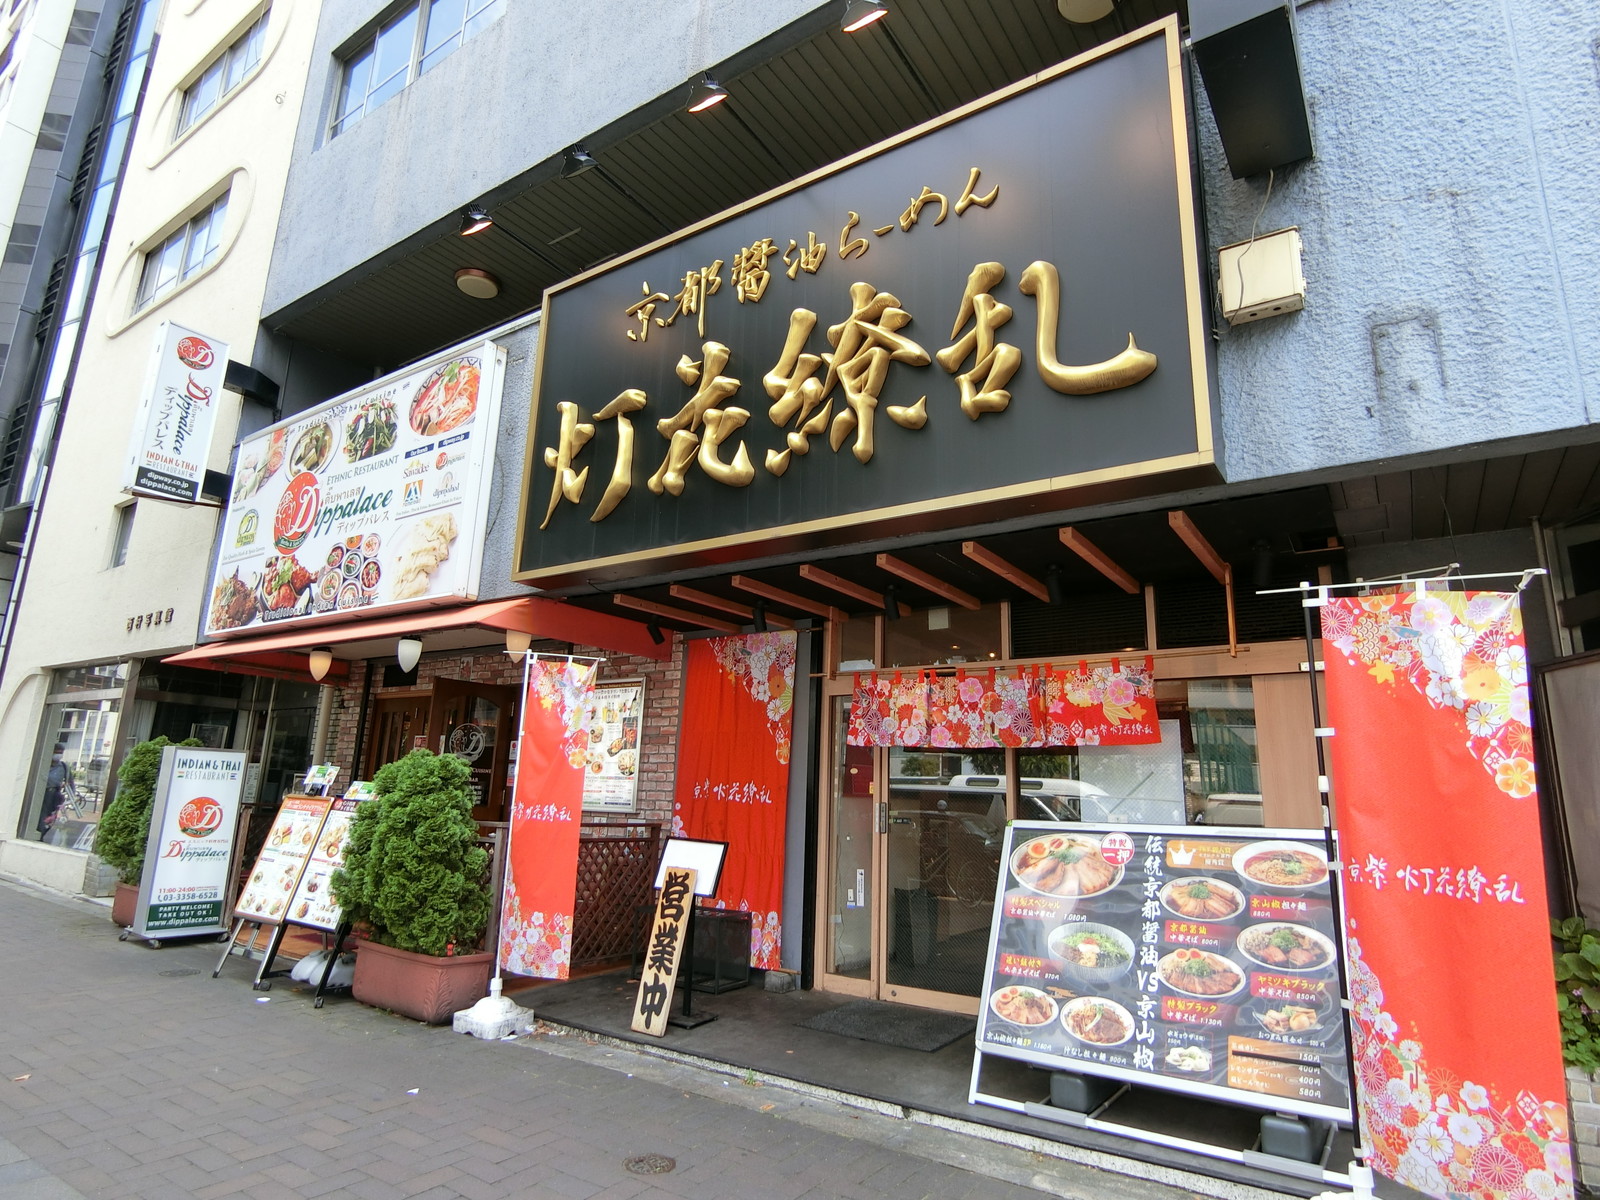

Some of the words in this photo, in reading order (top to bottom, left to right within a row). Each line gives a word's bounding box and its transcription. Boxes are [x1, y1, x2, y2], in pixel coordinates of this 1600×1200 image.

[540, 260, 1158, 531] 灯花繚乱
[146, 451, 173, 465] INDIAN
[181, 460, 198, 472] THAI
[152, 461, 189, 477] RESTAURANT
[327, 470, 353, 486] ETHNIC
[354, 455, 399, 476] RESTAURANT
[147, 471, 189, 489] dipway.co.jp
[140, 477, 193, 497] dippalace.com
[177, 758, 211, 769] INDIAN
[213, 760, 218, 770] &
[221, 761, 241, 771] THAI
[185, 771, 229, 780] RESTAURANT
[1108, 838, 1127, 848] 特製
[161, 840, 228, 861] Dippalace
[1103, 850, 1130, 862] 一押
[163, 892, 218, 901] 03-3358-6528
[148, 916, 219, 927] www.dippalace.com
[1170, 923, 1207, 935] 京都醤油
[1169, 934, 1198, 944] 中華そば
[639, 871, 690, 1029] 営業中
[1257, 975, 1325, 991] ヤミツキブラック
[1258, 988, 1291, 998] 中華そば
[1167, 999, 1217, 1014] 特製ブラック
[1167, 1011, 1197, 1022] 中華そば
[1299, 1053, 1320, 1062] 150円
[1298, 1065, 1320, 1074] 400円
[1298, 1076, 1320, 1086] 400円
[1299, 1088, 1321, 1098] 580円
